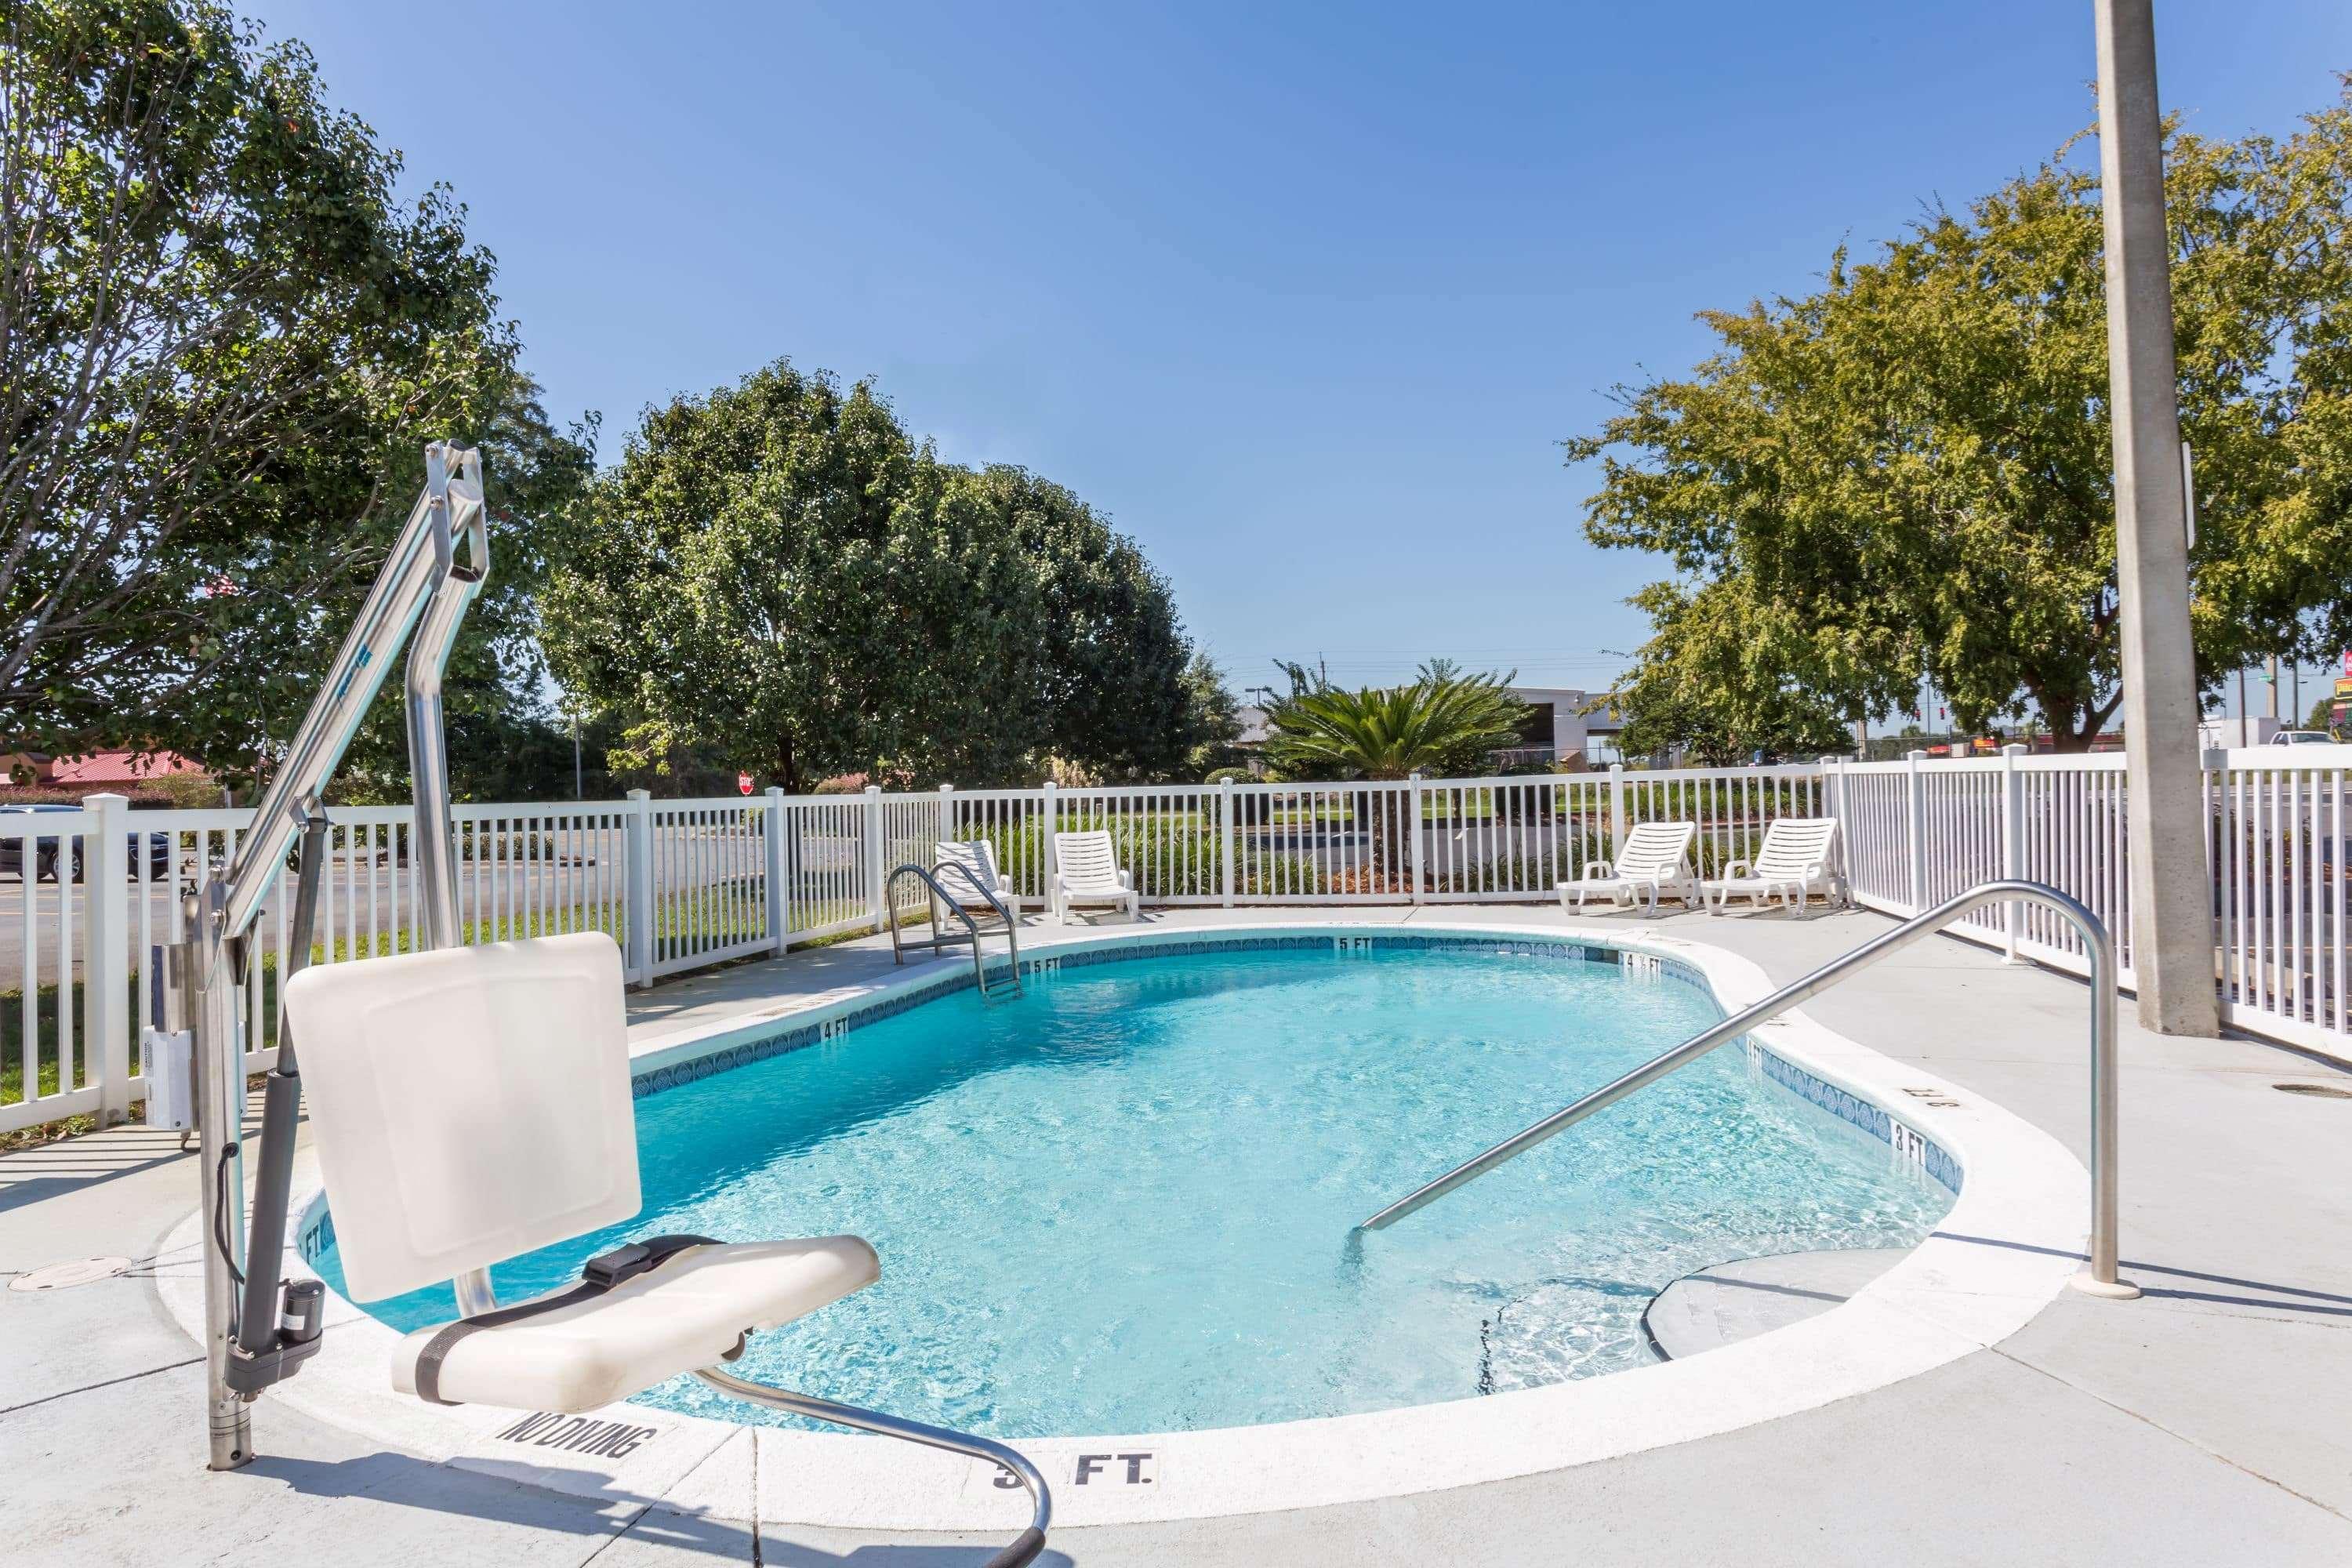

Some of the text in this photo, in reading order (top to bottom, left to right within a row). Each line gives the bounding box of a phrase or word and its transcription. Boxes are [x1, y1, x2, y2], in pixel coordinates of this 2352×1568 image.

[1339, 938, 1370, 949] 5 FT
[1034, 960, 1041, 973] 5
[1628, 954, 1633, 967] 4
[825, 1022, 831, 1039] 4
[1896, 1123, 1903, 1151] 3
[495, 1411, 658, 1459] NO DIVING
[1075, 1453, 1152, 1485] FT.
